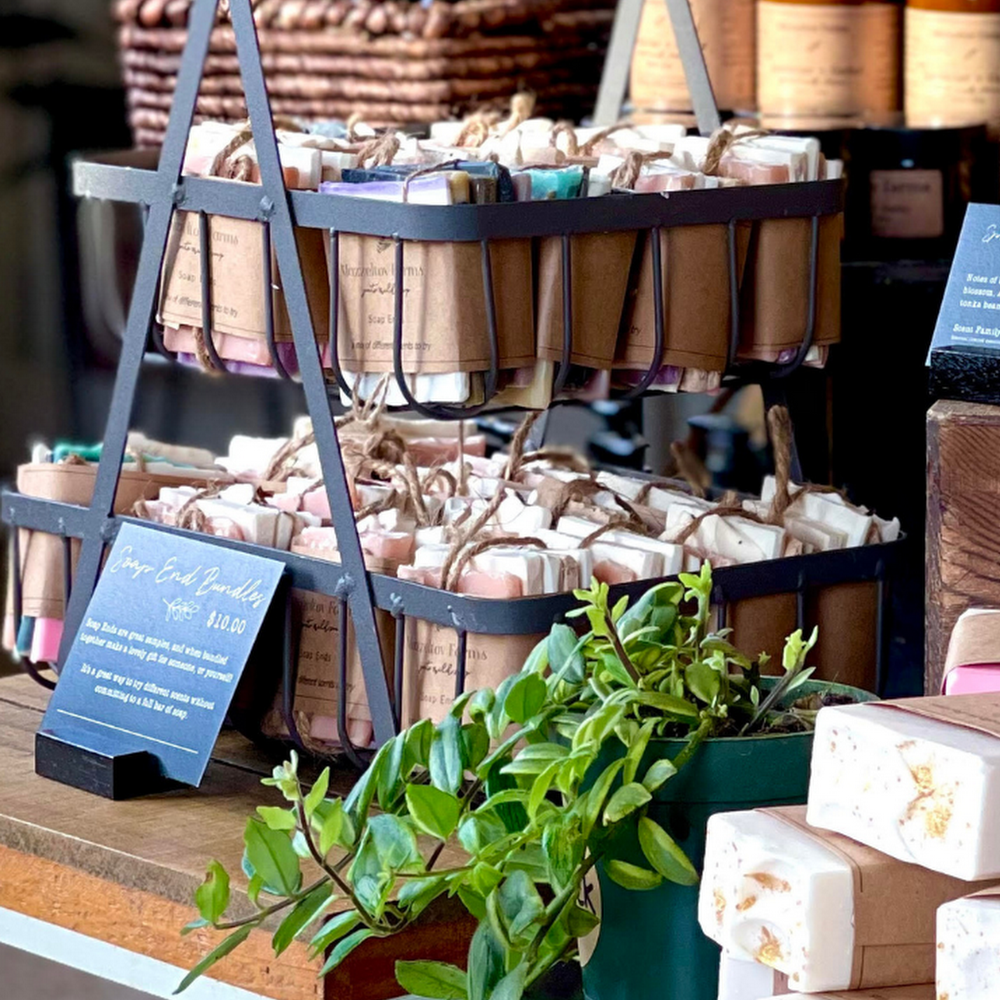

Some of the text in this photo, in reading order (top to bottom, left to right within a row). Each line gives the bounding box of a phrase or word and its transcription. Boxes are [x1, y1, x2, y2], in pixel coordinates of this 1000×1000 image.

[967, 274, 987, 284] Notes
[990, 276, 998, 284] of
[963, 286, 995, 298] blossom,
[960, 300, 981, 310] tonka
[953, 324, 973, 334] Scent
[110, 546, 154, 579] Soap
[155, 557, 202, 587] End
[195, 567, 266, 609] Bundles
[206, 610, 247, 635] $10.00
[85, 617, 101, 632] Soap
[101, 621, 117, 634] Ends
[117, 628, 128, 637] are
[128, 631, 144, 642] great
[171, 642, 185, 654] and
[185, 644, 202, 658] when
[202, 650, 229, 665] bundled
[80, 633, 106, 647] together
[106, 641, 122, 652] make
[128, 645, 147, 660] lovely
[146, 651, 158, 662] gift
[158, 654, 168, 665] for
[197, 666, 205, 674] or
[95, 669, 112, 681] great
[113, 673, 126, 686] way
[126, 677, 133, 685] to
[133, 678, 144, 691] try
[143, 681, 170, 697] different
[170, 689, 190, 703] scents
[190, 694, 215, 710] without
[129, 694, 137, 704] to
[141, 697, 155, 710] full
[153, 700, 164, 711] bar
[165, 705, 174, 715] of
